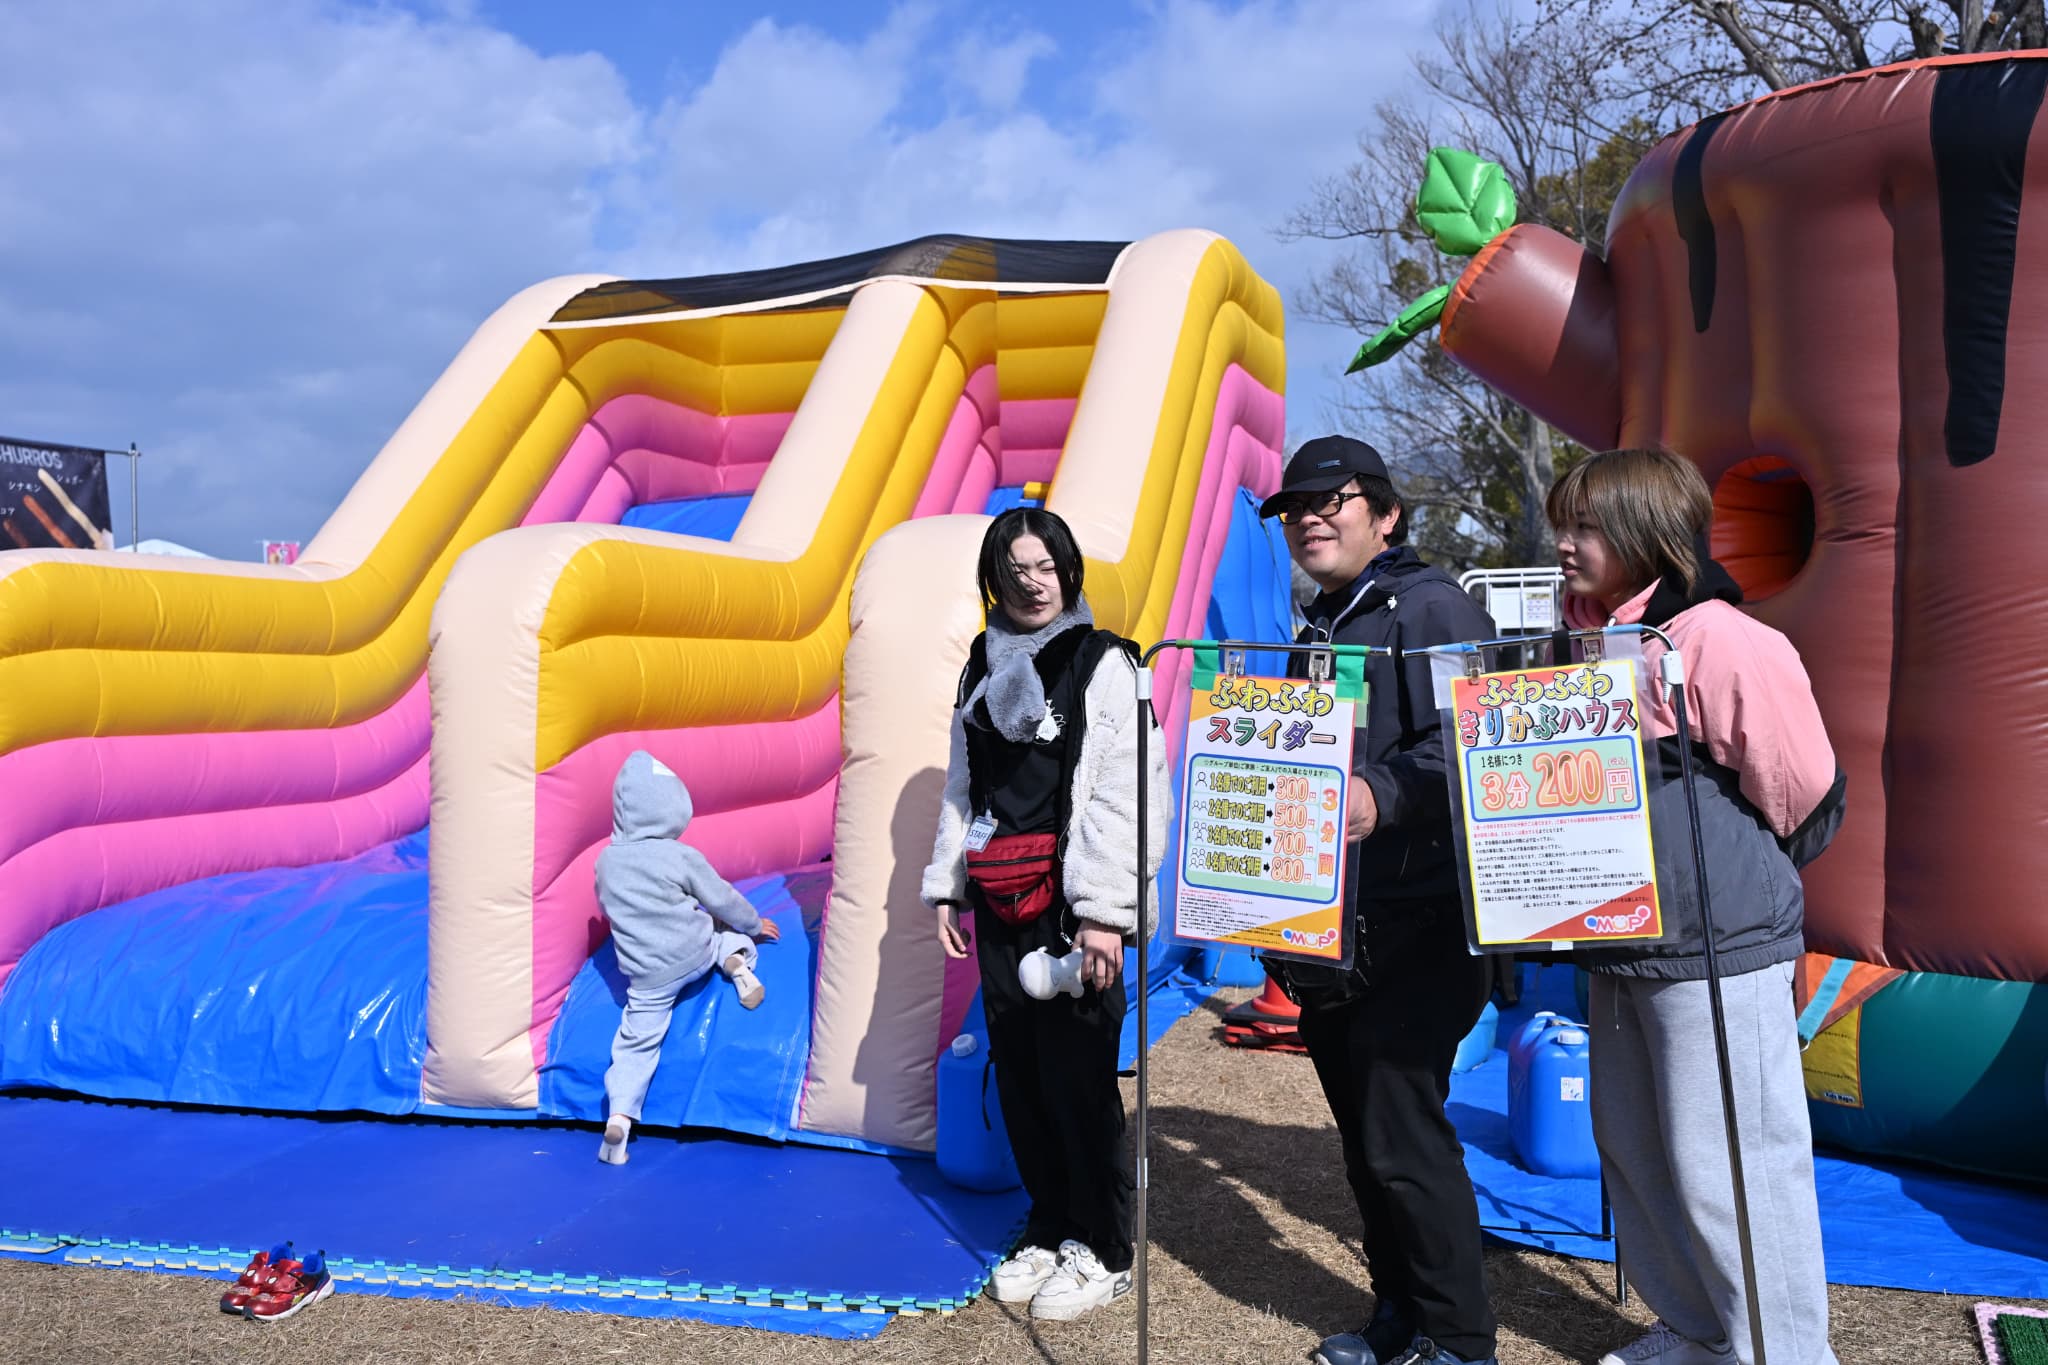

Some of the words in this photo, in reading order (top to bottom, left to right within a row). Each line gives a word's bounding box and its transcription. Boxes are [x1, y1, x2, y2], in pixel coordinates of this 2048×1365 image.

[0, 445, 63, 469] HURROS
[9, 481, 40, 493] シナモン
[1210, 679, 1334, 716] ふわふわ
[1478, 668, 1613, 707] ふわふわ
[1207, 716, 1336, 751] スライダー
[1459, 699, 1639, 747] きりかぶハウス
[1481, 754, 1523, 768] 1名様につき
